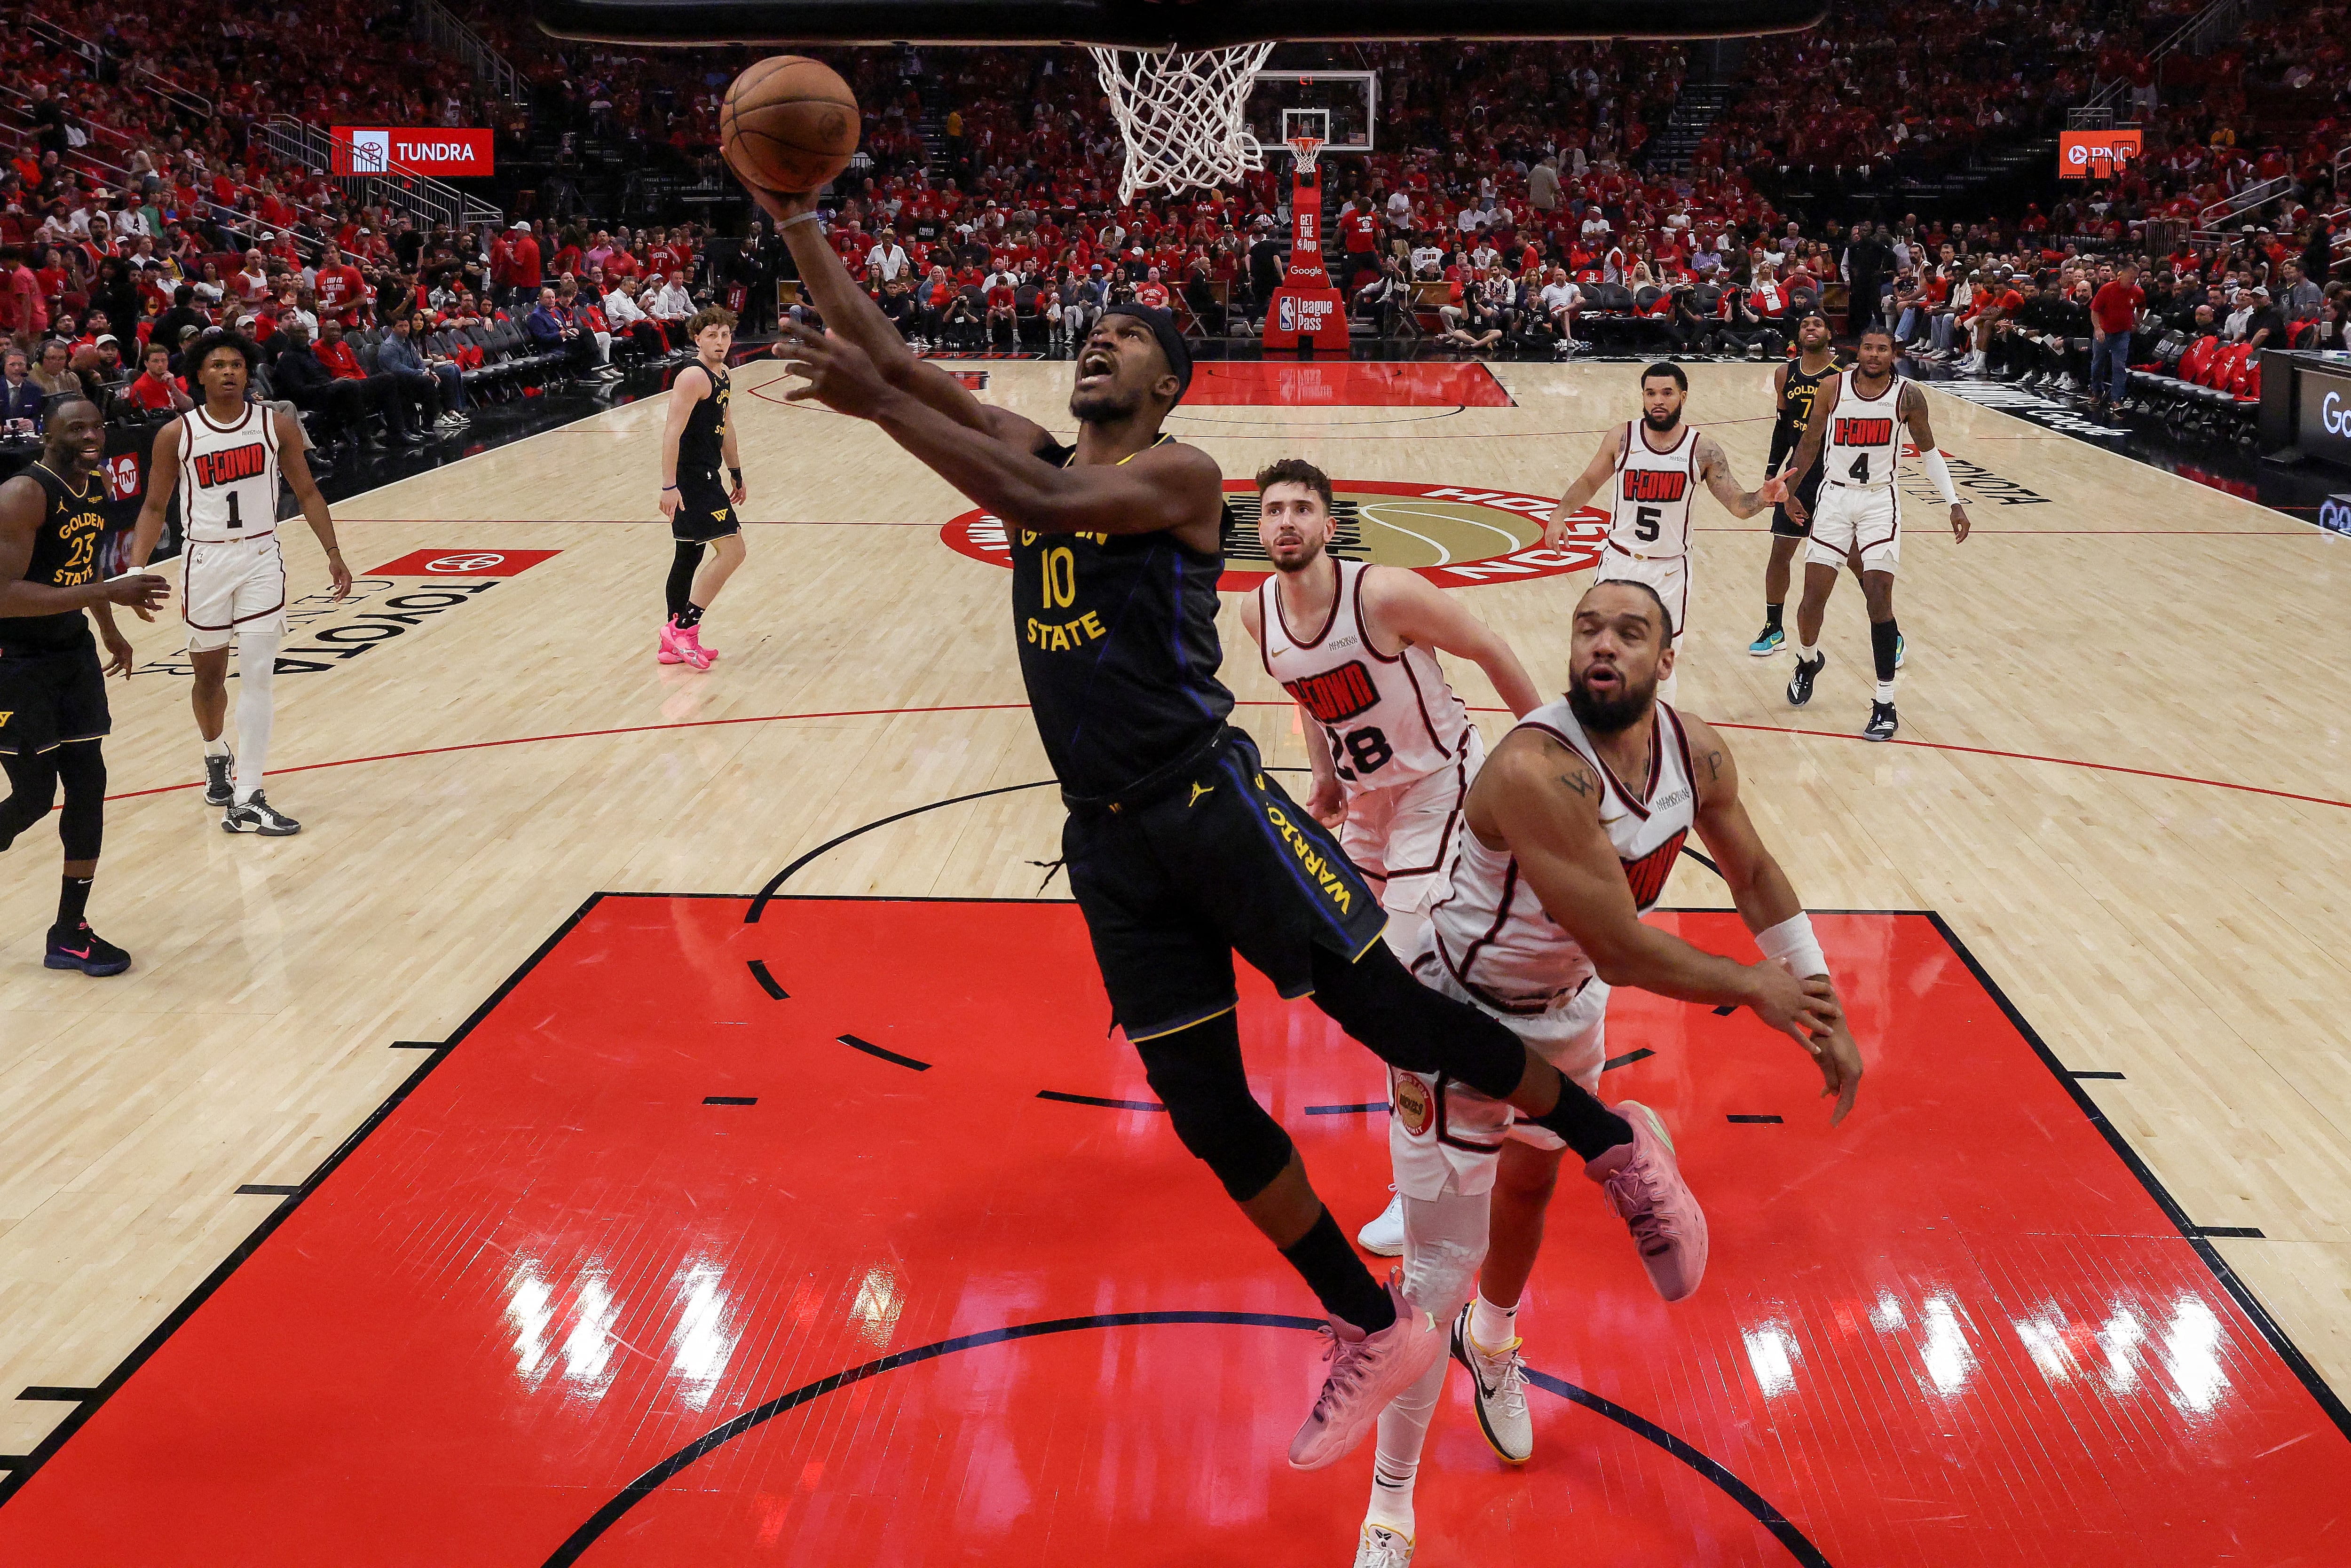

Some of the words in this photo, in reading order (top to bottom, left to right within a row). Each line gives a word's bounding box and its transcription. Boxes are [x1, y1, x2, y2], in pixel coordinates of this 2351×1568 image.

[396, 143, 475, 161] TUNDRA
[2090, 147, 2133, 162] PNC
[1300, 214, 1313, 226] GET
[1300, 226, 1313, 237] THE
[1303, 238, 1317, 252] App
[1290, 266, 1322, 276] Google
[1298, 297, 1333, 316] League
[1298, 314, 1322, 331] Pass
[1800, 399, 1812, 418] 7
[1793, 420, 1807, 432] STA
[1833, 418, 1893, 446] H-TOWN
[2026, 410, 2133, 436] Google
[194, 442, 265, 489] H-TOWN
[1848, 453, 1870, 484] 4
[1623, 469, 1687, 503] H-TOWN
[226, 491, 243, 529] 1
[59, 512, 104, 539] GOLDEN
[1634, 506, 1662, 542] 5
[64, 532, 96, 567] 23
[54, 564, 94, 586] STATE
[1041, 547, 1076, 609] 10
[1027, 610, 1106, 652] STATE
[1329, 635, 1357, 648] MEMORIAL
[1329, 640, 1358, 652] HERMANN
[1325, 726, 1394, 782] 28
